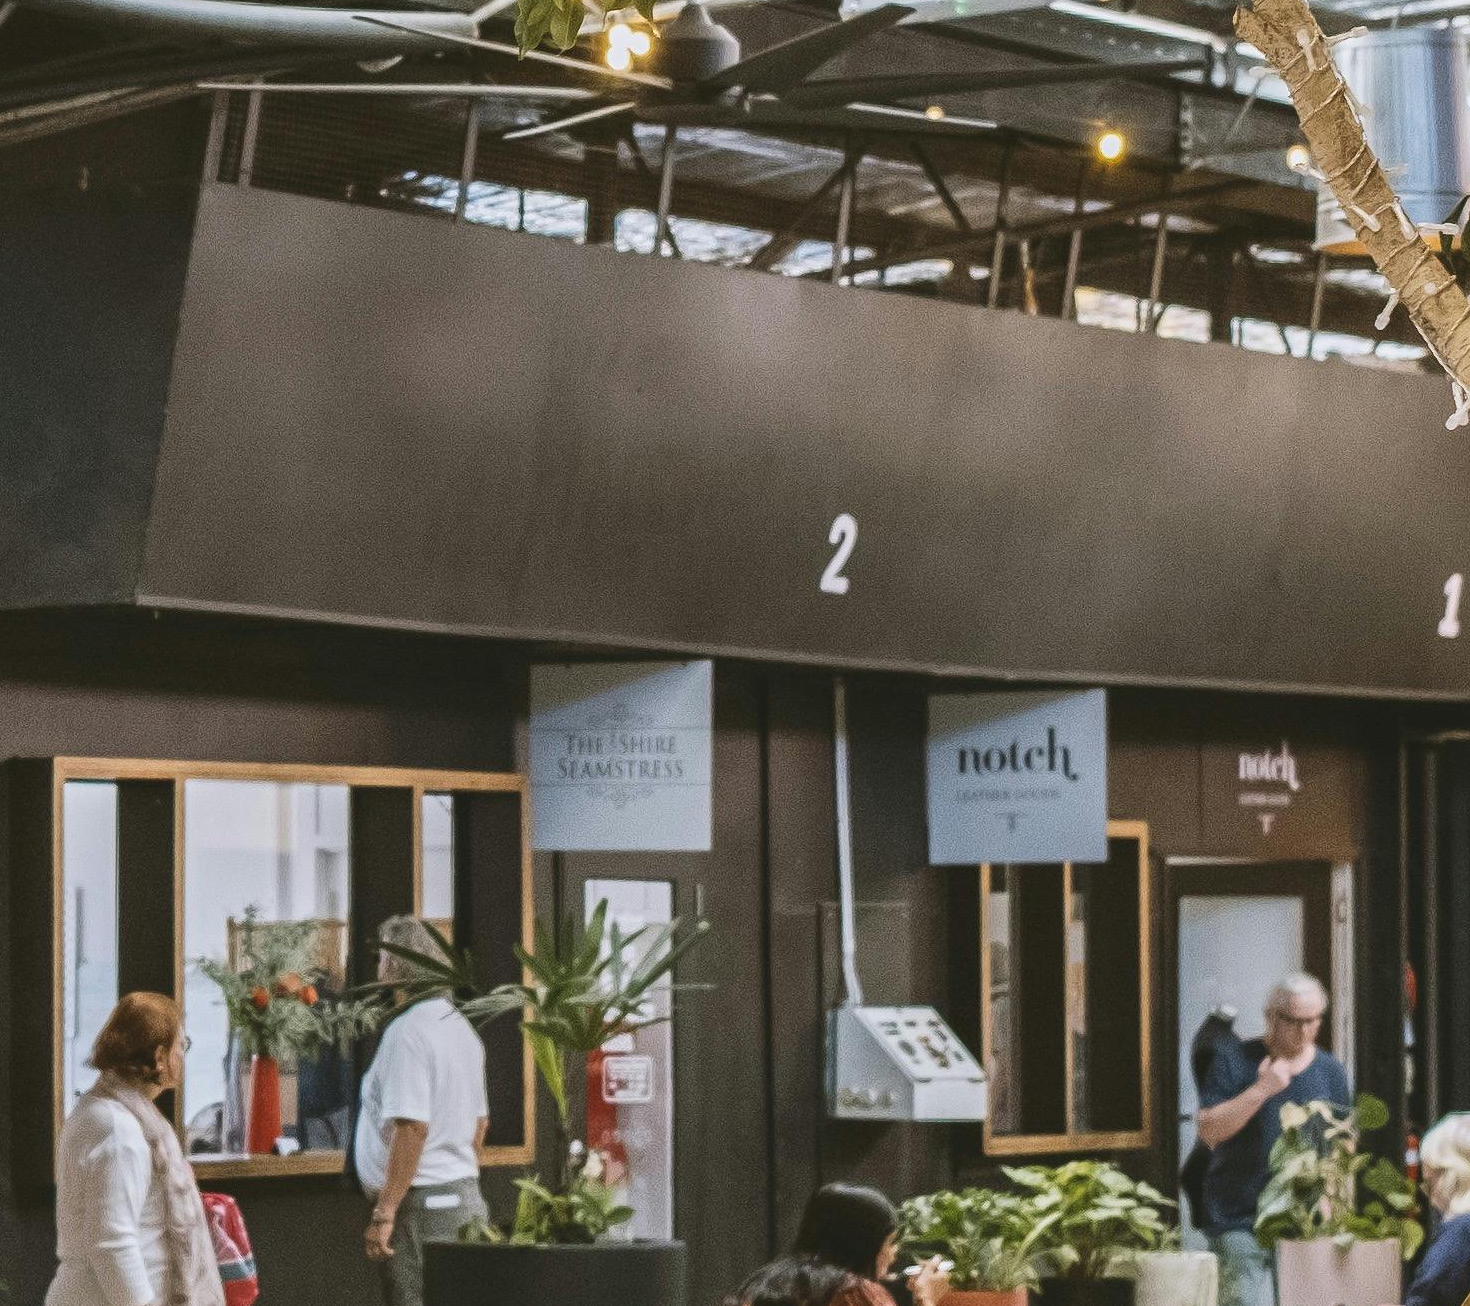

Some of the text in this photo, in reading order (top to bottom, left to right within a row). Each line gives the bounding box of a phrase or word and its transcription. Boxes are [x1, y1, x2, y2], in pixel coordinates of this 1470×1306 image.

[820, 512, 859, 595] 2
[1437, 572, 1463, 639] 1
[556, 757, 685, 780] SEAMSTRESS
[565, 732, 678, 756] THE SHIRE
[957, 724, 1079, 781] notch
[1238, 739, 1301, 791] notch
